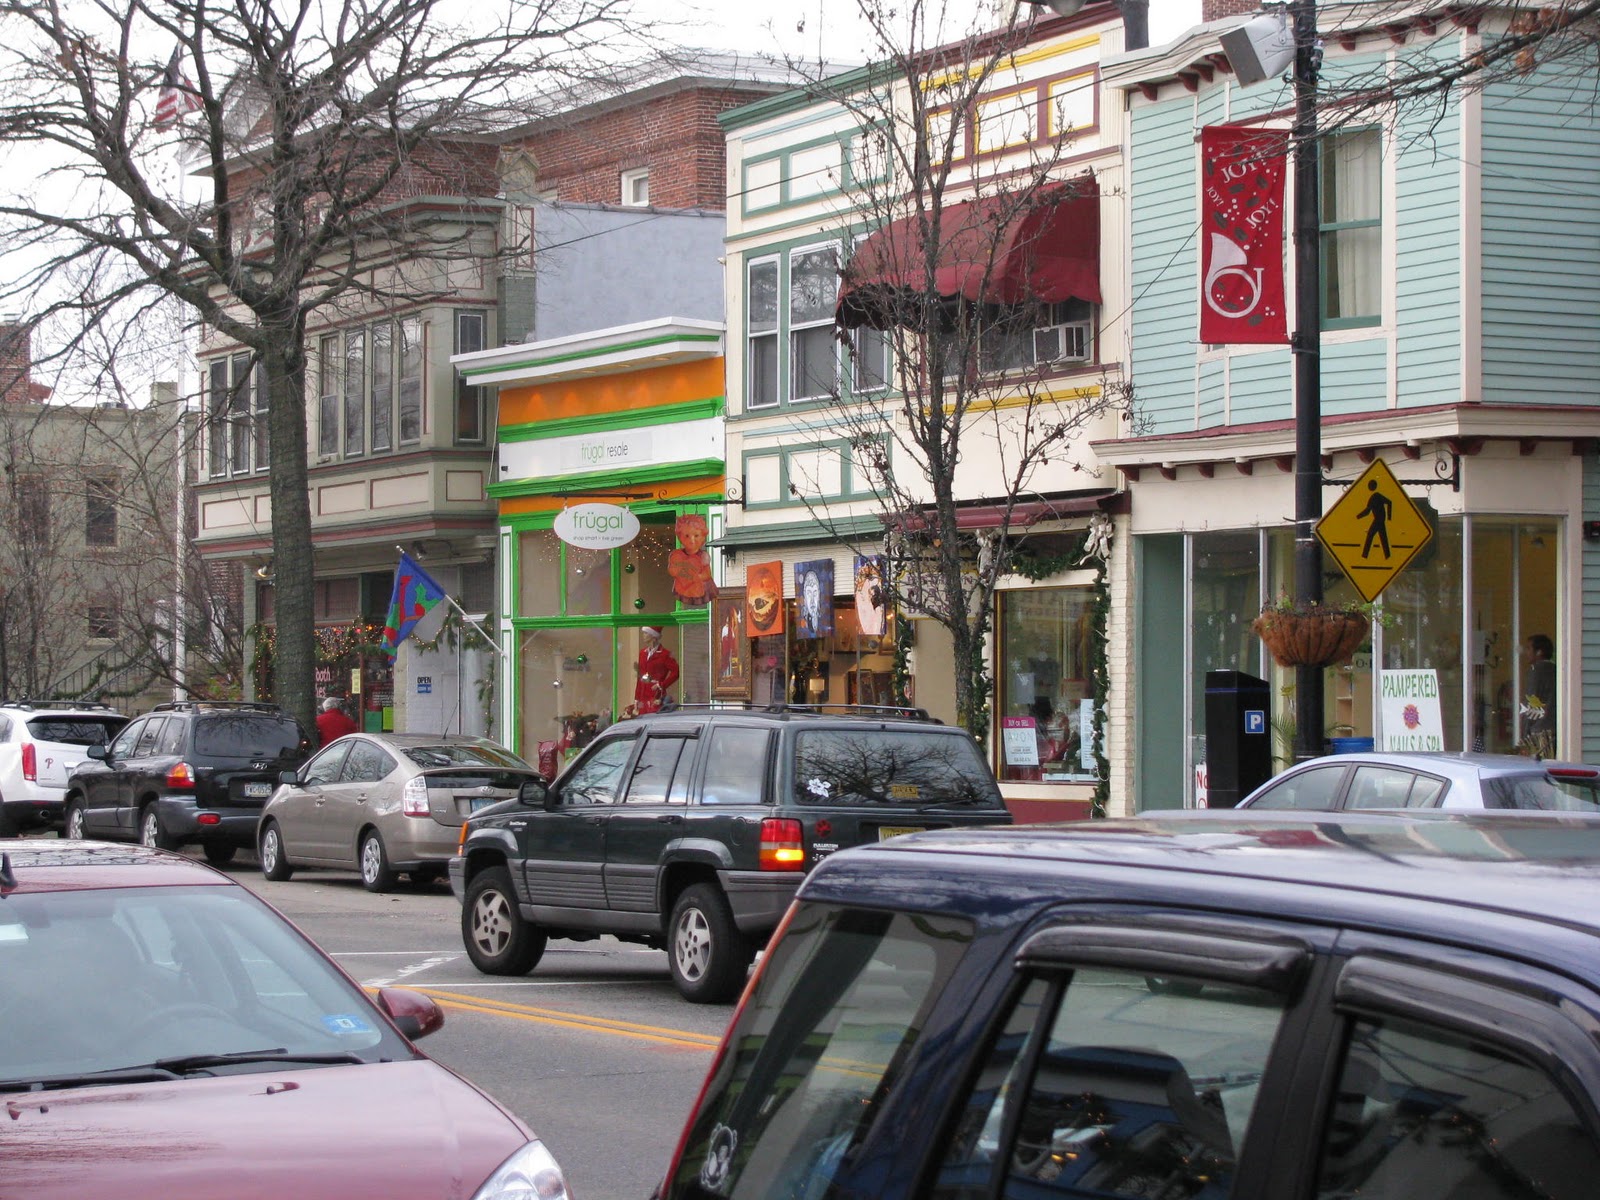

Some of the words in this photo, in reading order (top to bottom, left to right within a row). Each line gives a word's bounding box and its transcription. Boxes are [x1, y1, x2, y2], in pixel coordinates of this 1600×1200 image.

[1206, 187, 1225, 207] JOY!
[1245, 198, 1279, 229] JOY!
[607, 441, 628, 457] resale
[573, 511, 623, 533] frügal
[1382, 674, 1437, 698] PAMPERED
[1250, 714, 1262, 730] P
